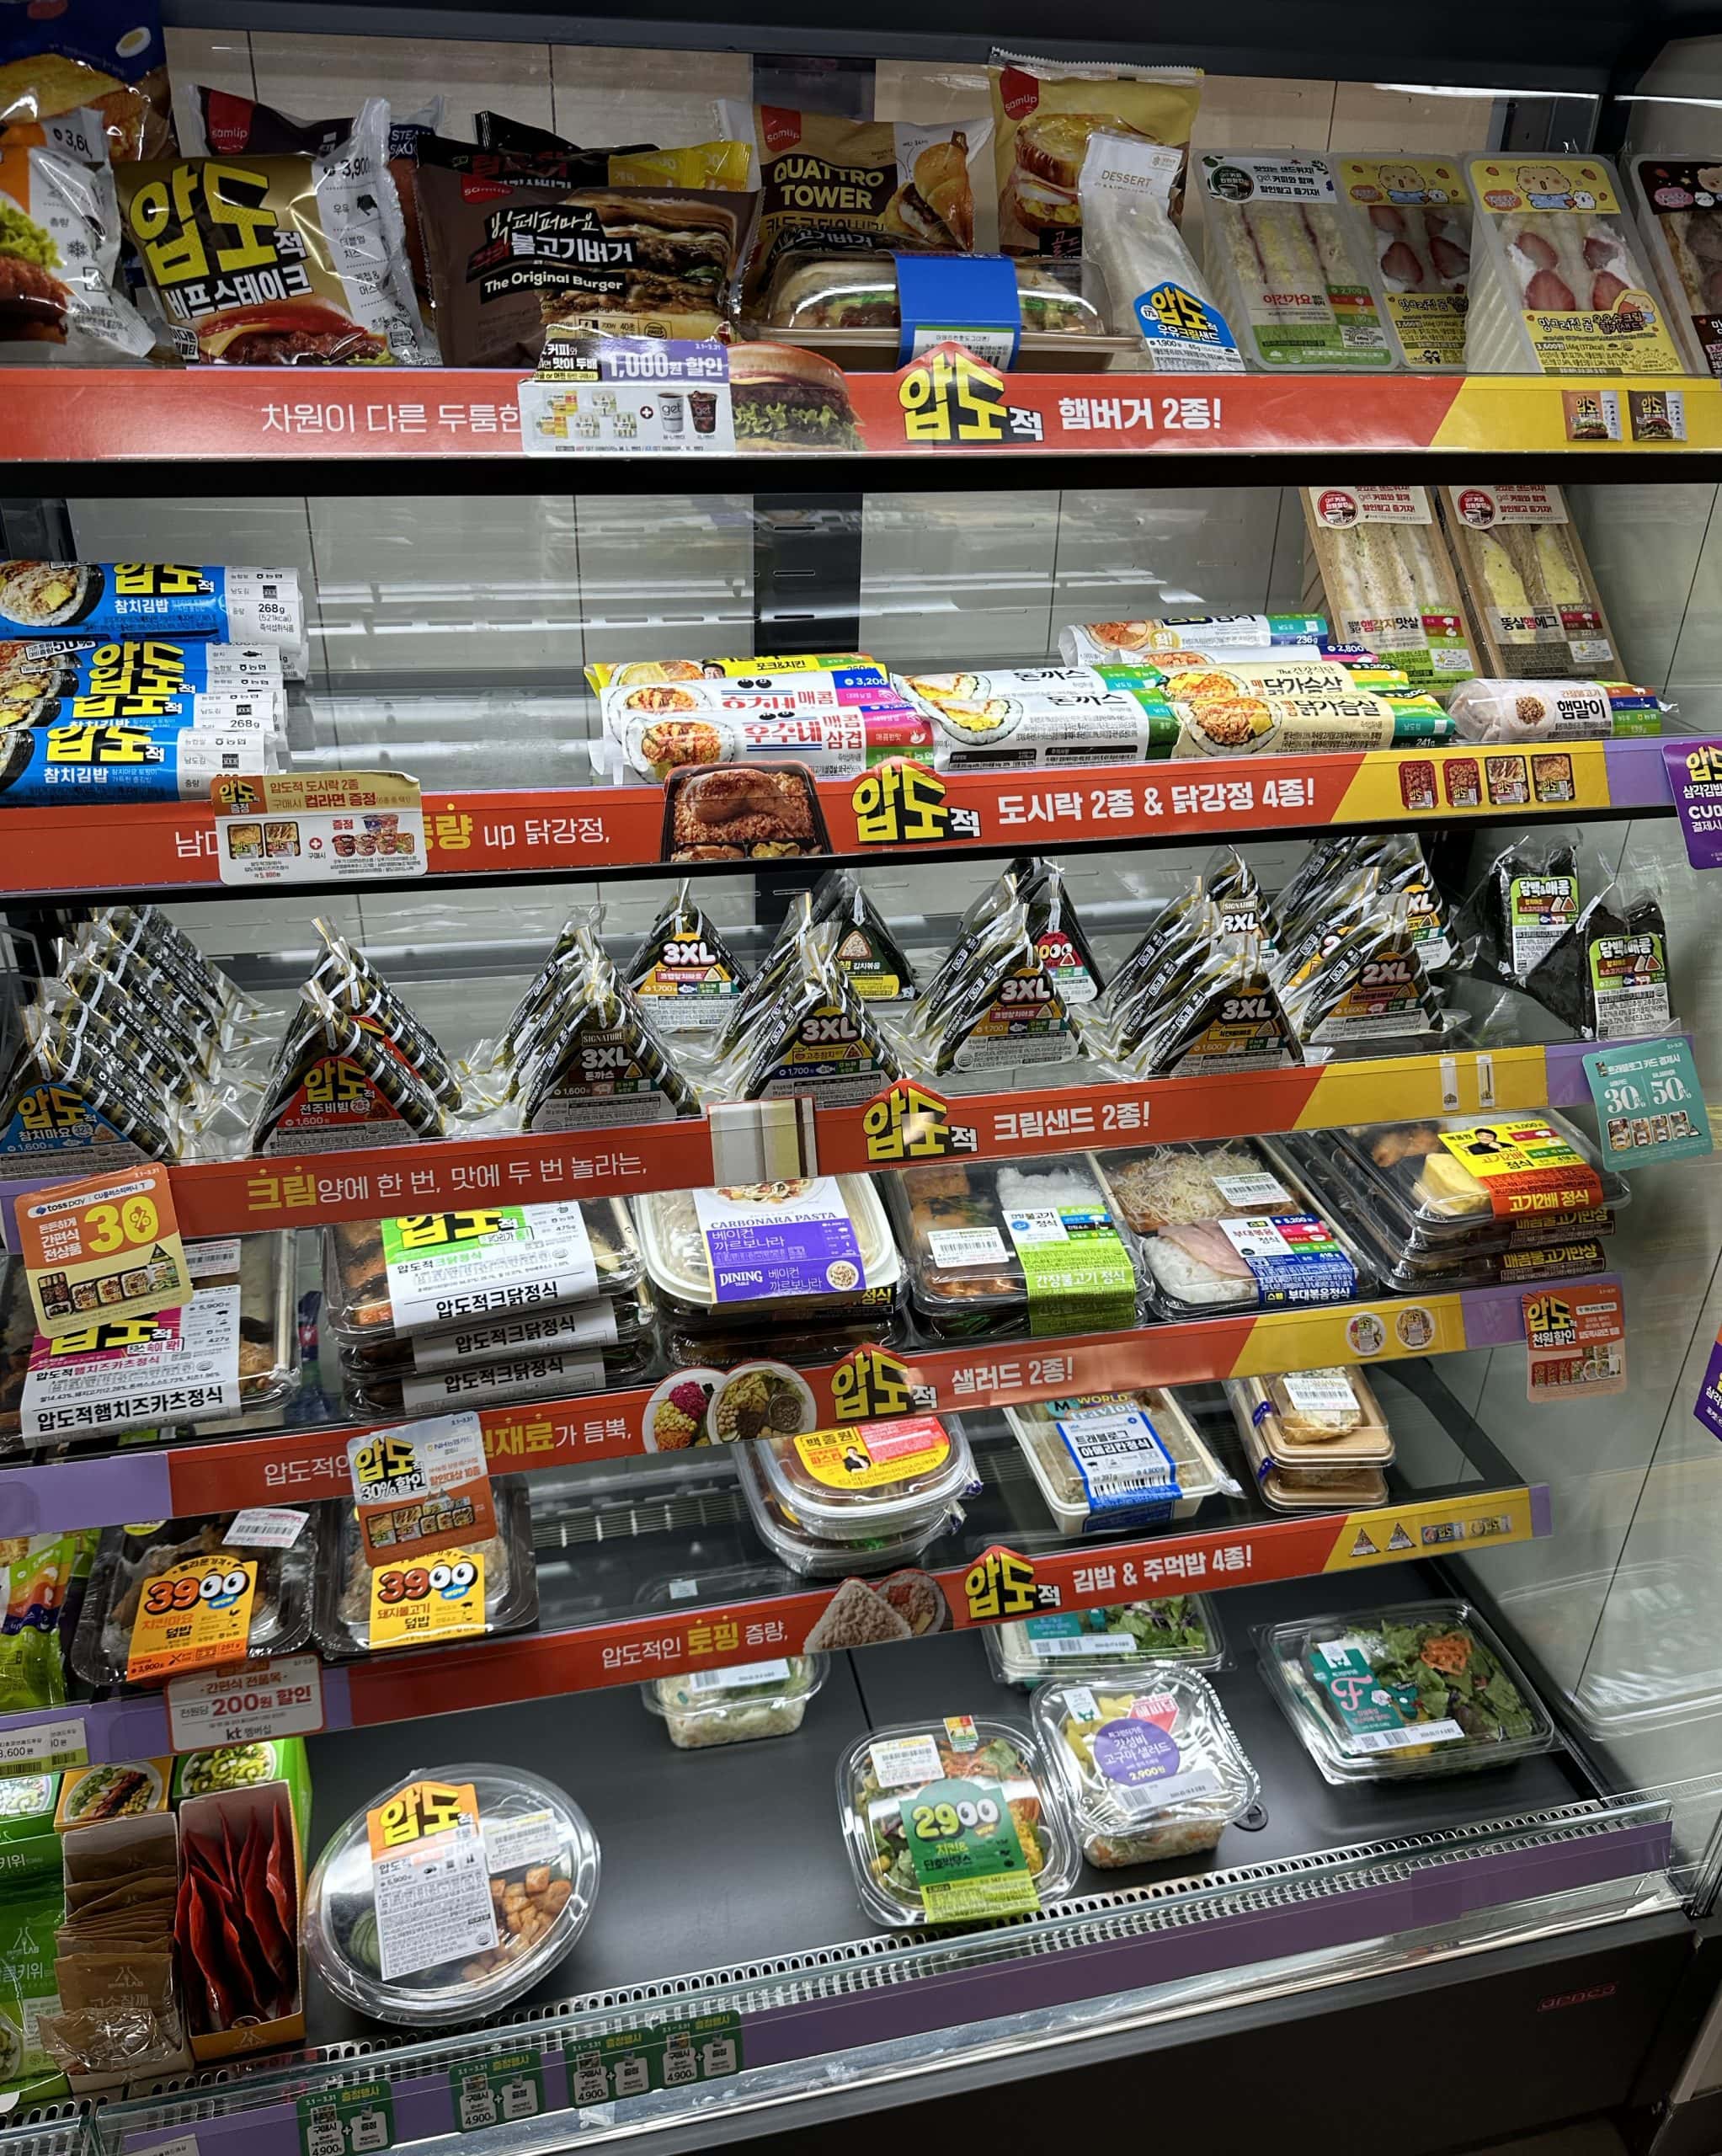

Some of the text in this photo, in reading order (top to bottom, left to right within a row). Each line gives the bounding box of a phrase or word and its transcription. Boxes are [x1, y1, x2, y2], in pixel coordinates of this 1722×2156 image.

[1004, 95, 1037, 112] samlip
[212, 126, 248, 140] samlip
[774, 157, 884, 187] QUATTRO
[1101, 169, 1152, 188] DESSERT
[781, 184, 872, 210] TOWER
[130, 162, 304, 285] 압도적
[511, 232, 633, 263] 불고기버거
[165, 264, 313, 322] 비프스테이크
[485, 271, 623, 294] The Original Burger
[553, 356, 598, 371] 맛이 두배
[610, 351, 724, 377] 1,000원 할인
[898, 351, 1044, 442] 압도적
[261, 403, 520, 435] 차원이 다른 두툼한
[1058, 397, 1223, 430] 햄버거 2종!
[113, 562, 216, 594] 압도적
[115, 599, 169, 615] 참치김밥
[259, 603, 285, 615] 268g
[1296, 634, 1319, 645] 236g
[856, 677, 887, 687] 3,200
[799, 691, 834, 705] 매콤
[1048, 694, 1128, 706] 돈까스
[1295, 700, 1379, 717] 닭가슴살
[1557, 699, 1607, 720] 햄말이
[230, 718, 260, 730] 268g
[822, 713, 861, 728] 매콤
[46, 726, 165, 762] 압도적
[825, 731, 862, 750] 삼겹
[44, 767, 109, 784] 참치김밥
[269, 778, 359, 793] 압도적 도시락 2종
[230, 803, 250, 814] 증정
[273, 792, 376, 809] 구매시 컵라면 증정
[850, 763, 980, 843] 압도적
[998, 777, 1314, 825] 도시락 2종 & 닭강정 4종!
[332, 819, 354, 830] 증정
[484, 815, 610, 850] up 닭강정,
[663, 942, 717, 966] 3XL
[1362, 961, 1412, 985] 2XL
[1000, 979, 1053, 1002] 3XL
[1221, 998, 1272, 1020] 3XL
[583, 1032, 624, 1044] SIGNATURE
[802, 1018, 858, 1041] 3XL
[581, 1047, 632, 1070] 3XL
[303, 1060, 376, 1103] 압도적
[17, 1087, 97, 1129] 압도적
[298, 1101, 350, 1114] 전주비빔
[294, 1116, 324, 1126] 1,600
[862, 1086, 978, 1161] 압도적
[993, 1101, 1151, 1141] 크림샌드 2종!
[19, 1126, 72, 1141] 참치마요
[17, 1142, 48, 1152] 1,600
[376, 1171, 403, 1198] 한
[410, 1169, 440, 1197] 번,
[450, 1164, 500, 1192] 맛에
[507, 1161, 530, 1186] 두
[540, 1159, 564, 1184] 번
[570, 1152, 648, 1179] 놀라는,
[1505, 1159, 1535, 1170] 정식
[46, 1198, 86, 1214] toss pay
[1508, 1189, 1590, 1213] 고기2배 정식
[711, 1211, 837, 1230] CARBONARA PASTA
[40, 1230, 81, 1250] 간편식
[712, 1228, 755, 1241] 베이컨
[714, 1236, 785, 1252] 까르보나라
[44, 1244, 83, 1263] 전상품
[1503, 1246, 1597, 1269] 매콤불고기반상
[718, 1269, 764, 1288] DINING
[767, 1267, 801, 1279] 베이컨
[1035, 1268, 1127, 1289] 간장불고기 정식
[769, 1277, 823, 1292] 까르보나라
[435, 1280, 559, 1320] 압도적크닭정식
[1288, 1289, 1351, 1302] 부대볶음정식
[1527, 1295, 1578, 1331] 압도적
[455, 1315, 576, 1354] 압도적크닭정식
[444, 1357, 563, 1394] 압도적크닭정식
[830, 1349, 938, 1420] 압도적
[952, 1356, 1074, 1395] 샐러드 2종!
[37, 1385, 223, 1433] 압도적햄치즈카츠정식
[1053, 1394, 1129, 1412] M WORLD
[583, 1418, 632, 1445] 듬뿍,
[805, 1430, 857, 1449] 백종원
[1074, 1430, 1131, 1445] 트래블로그
[1080, 1438, 1153, 1458] 아메리칸정식
[355, 1435, 425, 1483] 압도적
[1072, 1544, 1253, 1593] 김밥 & 주먹밥 4종!
[144, 1570, 250, 1615] 3900
[377, 1561, 478, 1604] 3900
[965, 1551, 1061, 1620] 압도적
[141, 1613, 195, 1630] 치킨마요
[377, 1603, 431, 1620] 돼지불고기
[165, 1625, 193, 1639] 덮밥
[404, 1615, 430, 1630] 덮밥
[601, 1615, 788, 1670] 압도적인 토핑 증량,
[206, 1678, 243, 1694] 간편식
[211, 1685, 312, 1717] 200원 할인
[226, 1724, 272, 1741] kt 멤버십
[1114, 1735, 1149, 1749] 갓성비
[1104, 1742, 1171, 1767] 고구마 샐러드
[912, 1798, 1000, 1843] 2900
